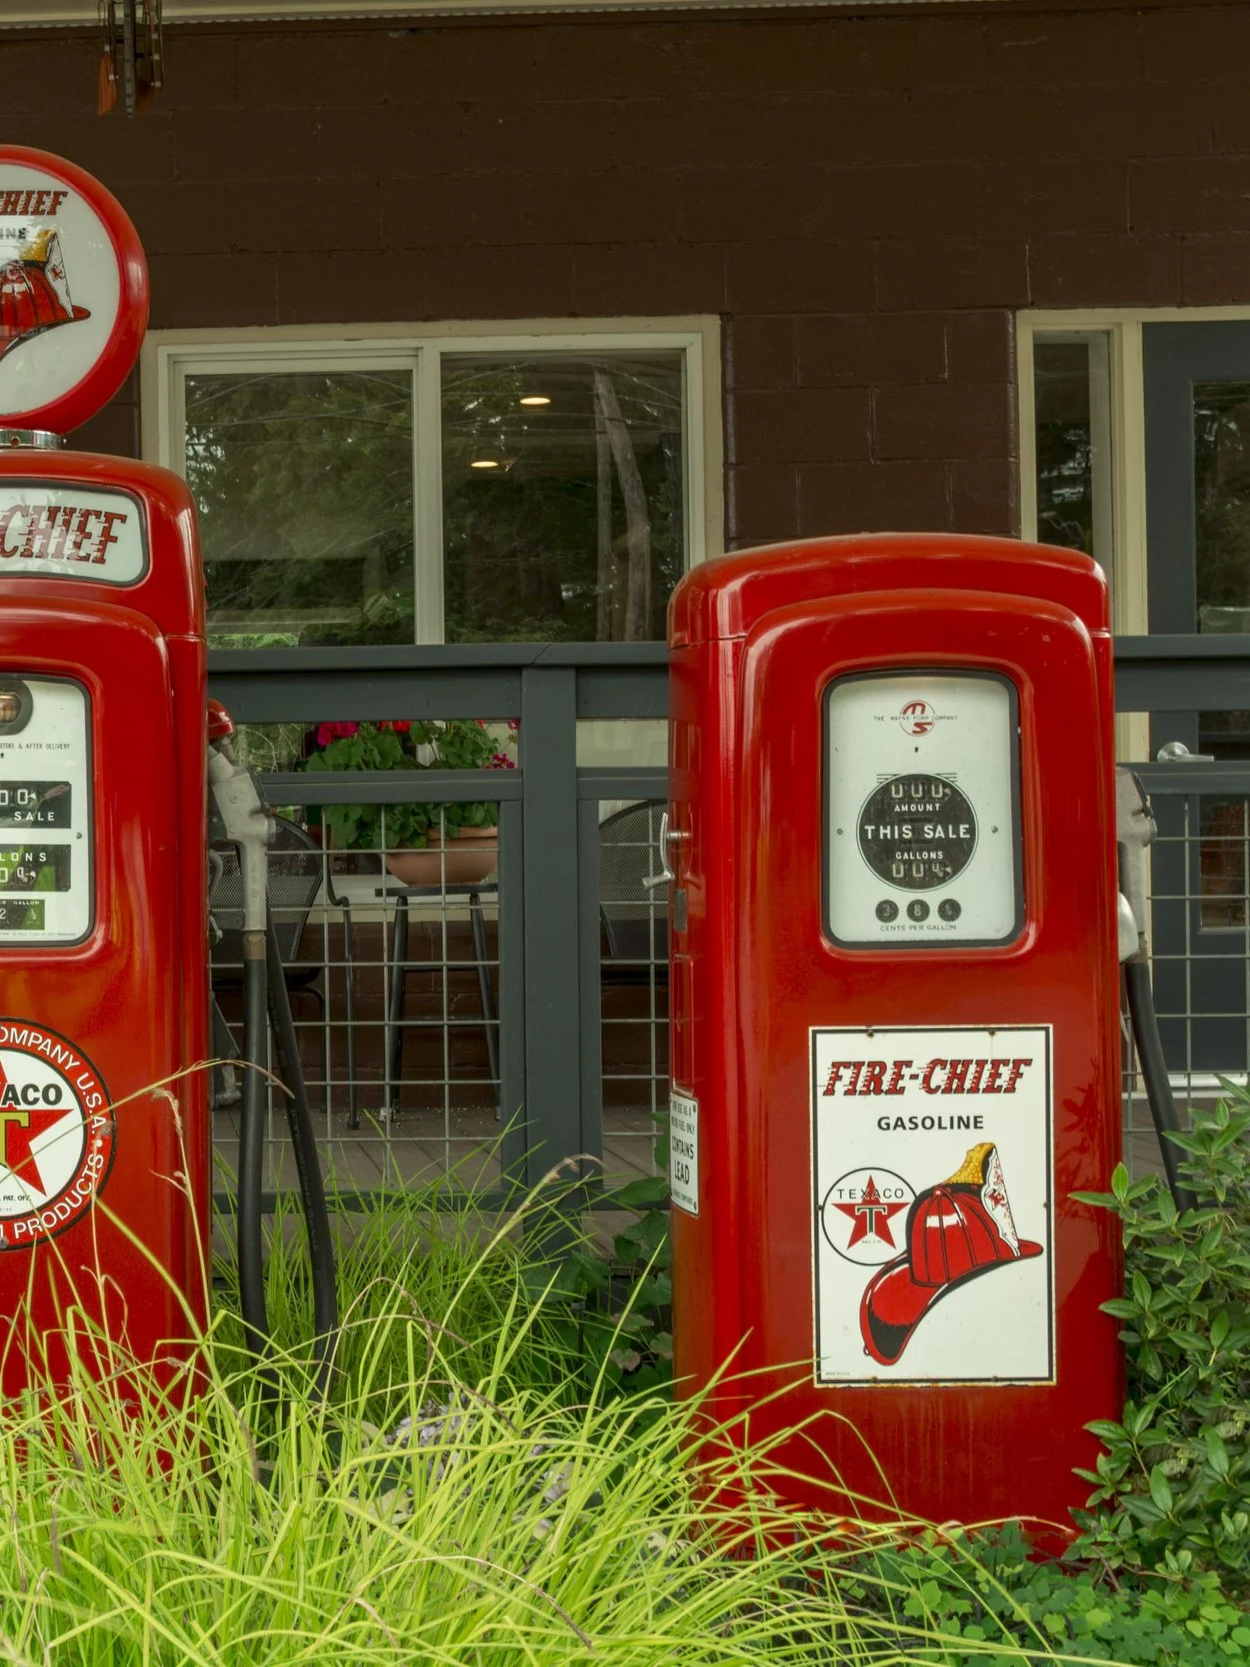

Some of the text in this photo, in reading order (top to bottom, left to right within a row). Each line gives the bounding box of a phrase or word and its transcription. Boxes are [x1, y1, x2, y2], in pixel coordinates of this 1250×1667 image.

[894, 803, 941, 812] AMOUNT
[14, 811, 55, 822] SALE
[864, 824, 971, 840] THIS SALE
[895, 850, 944, 860] GALLONS
[822, 1058, 1034, 1096] FIRE-CHIEF
[877, 1115, 985, 1131] GASOLINE
[672, 1135, 694, 1160] CONTAINS
[674, 1160, 690, 1185] LEAD
[14, 1154, 104, 1240] PRODUCTS
[838, 1188, 904, 1200] TEXACO
